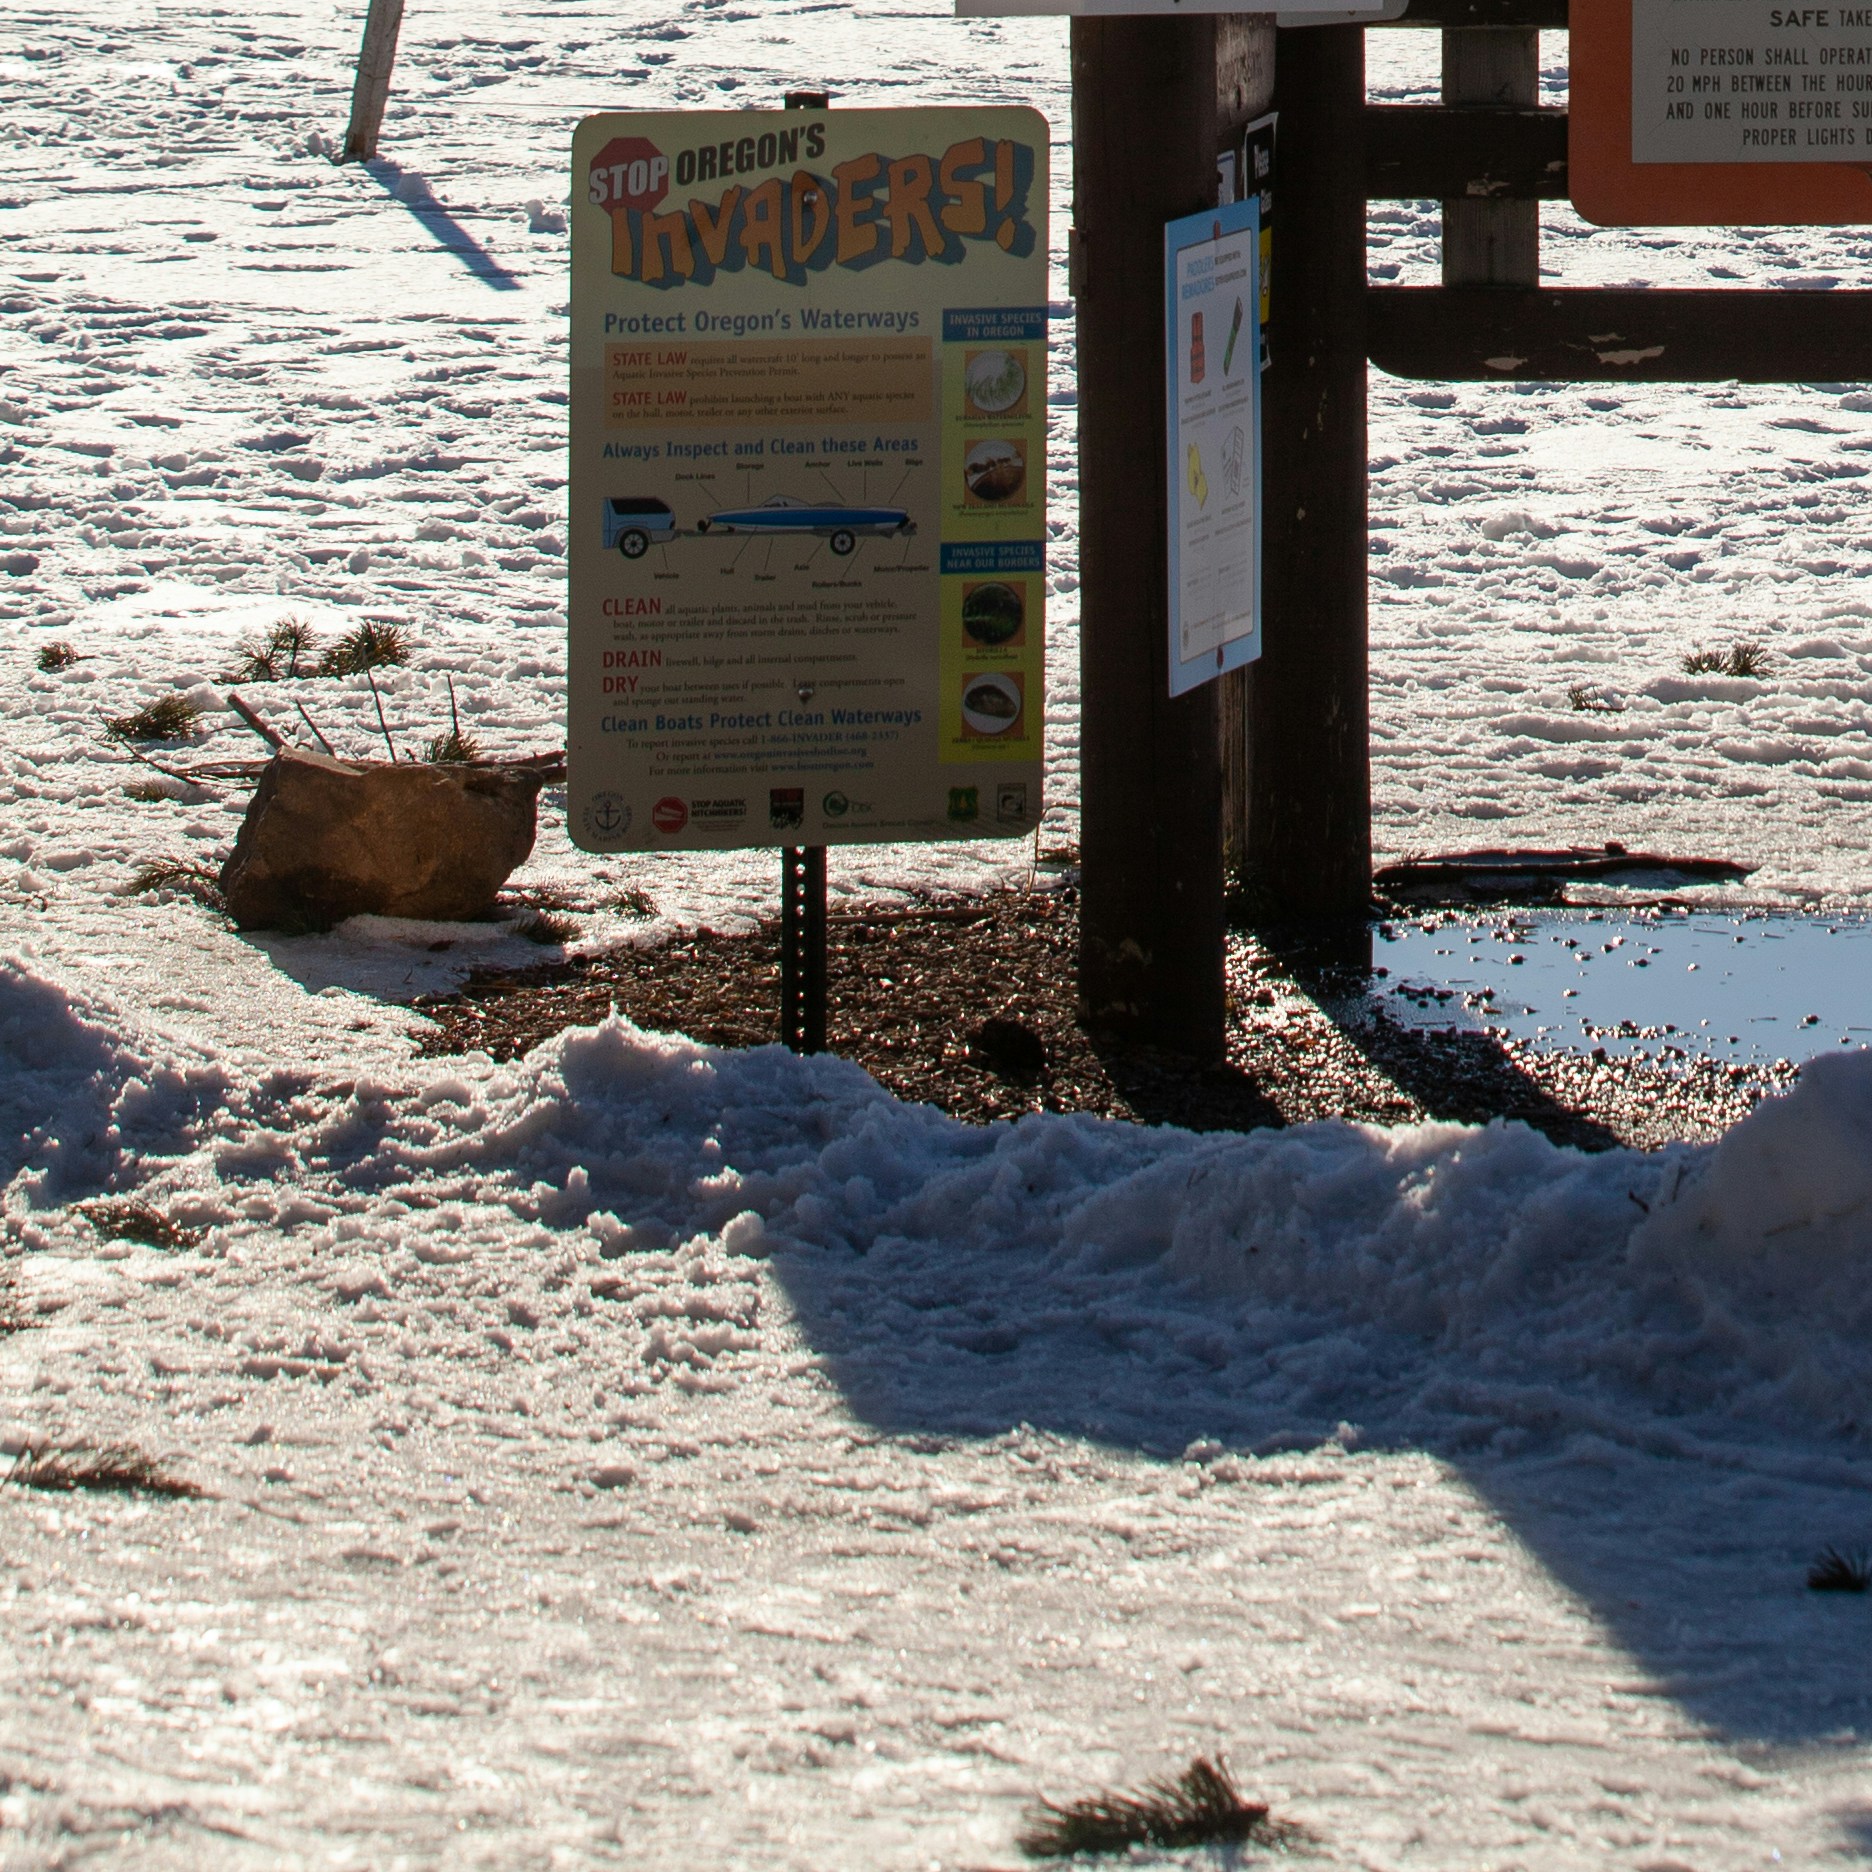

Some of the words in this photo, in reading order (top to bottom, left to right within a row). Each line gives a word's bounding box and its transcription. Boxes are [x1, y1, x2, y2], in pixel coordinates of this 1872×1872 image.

[1769, 9, 1829, 27] SAFE
[588, 155, 669, 206] STOP
[676, 123, 826, 186] OREGON'S
[603, 312, 686, 333] Protect
[694, 309, 791, 336] Oregon's
[800, 309, 919, 332] Waterways
[949, 313, 997, 325] INVASIVE
[1001, 311, 1042, 323] SPECIES
[967, 326, 980, 337] IN
[982, 325, 1024, 336] OREGON
[613, 352, 651, 366] STATE
[657, 351, 687, 365] LAW
[612, 391, 651, 405] STATE
[657, 391, 688, 405] LAW
[602, 442, 659, 461] Always
[666, 441, 728, 459] Inspect
[733, 439, 763, 455] and
[770, 438, 815, 454] Clean
[821, 437, 866, 453] these
[872, 436, 918, 451] Areas
[951, 546, 995, 557] INVASIVE
[998, 545, 1035, 555] SPECIES
[946, 559, 972, 568] NEAR
[975, 558, 995, 568] OUR
[998, 557, 1039, 567] BORDERS
[602, 597, 661, 615] CLEAN
[603, 650, 661, 667] DRAIN
[602, 675, 639, 693] DRY
[601, 716, 648, 732] Clean
[655, 714, 703, 730] Boats
[710, 712, 772, 728] Protect
[778, 710, 824, 726] Clean
[831, 709, 921, 726] Waterways
